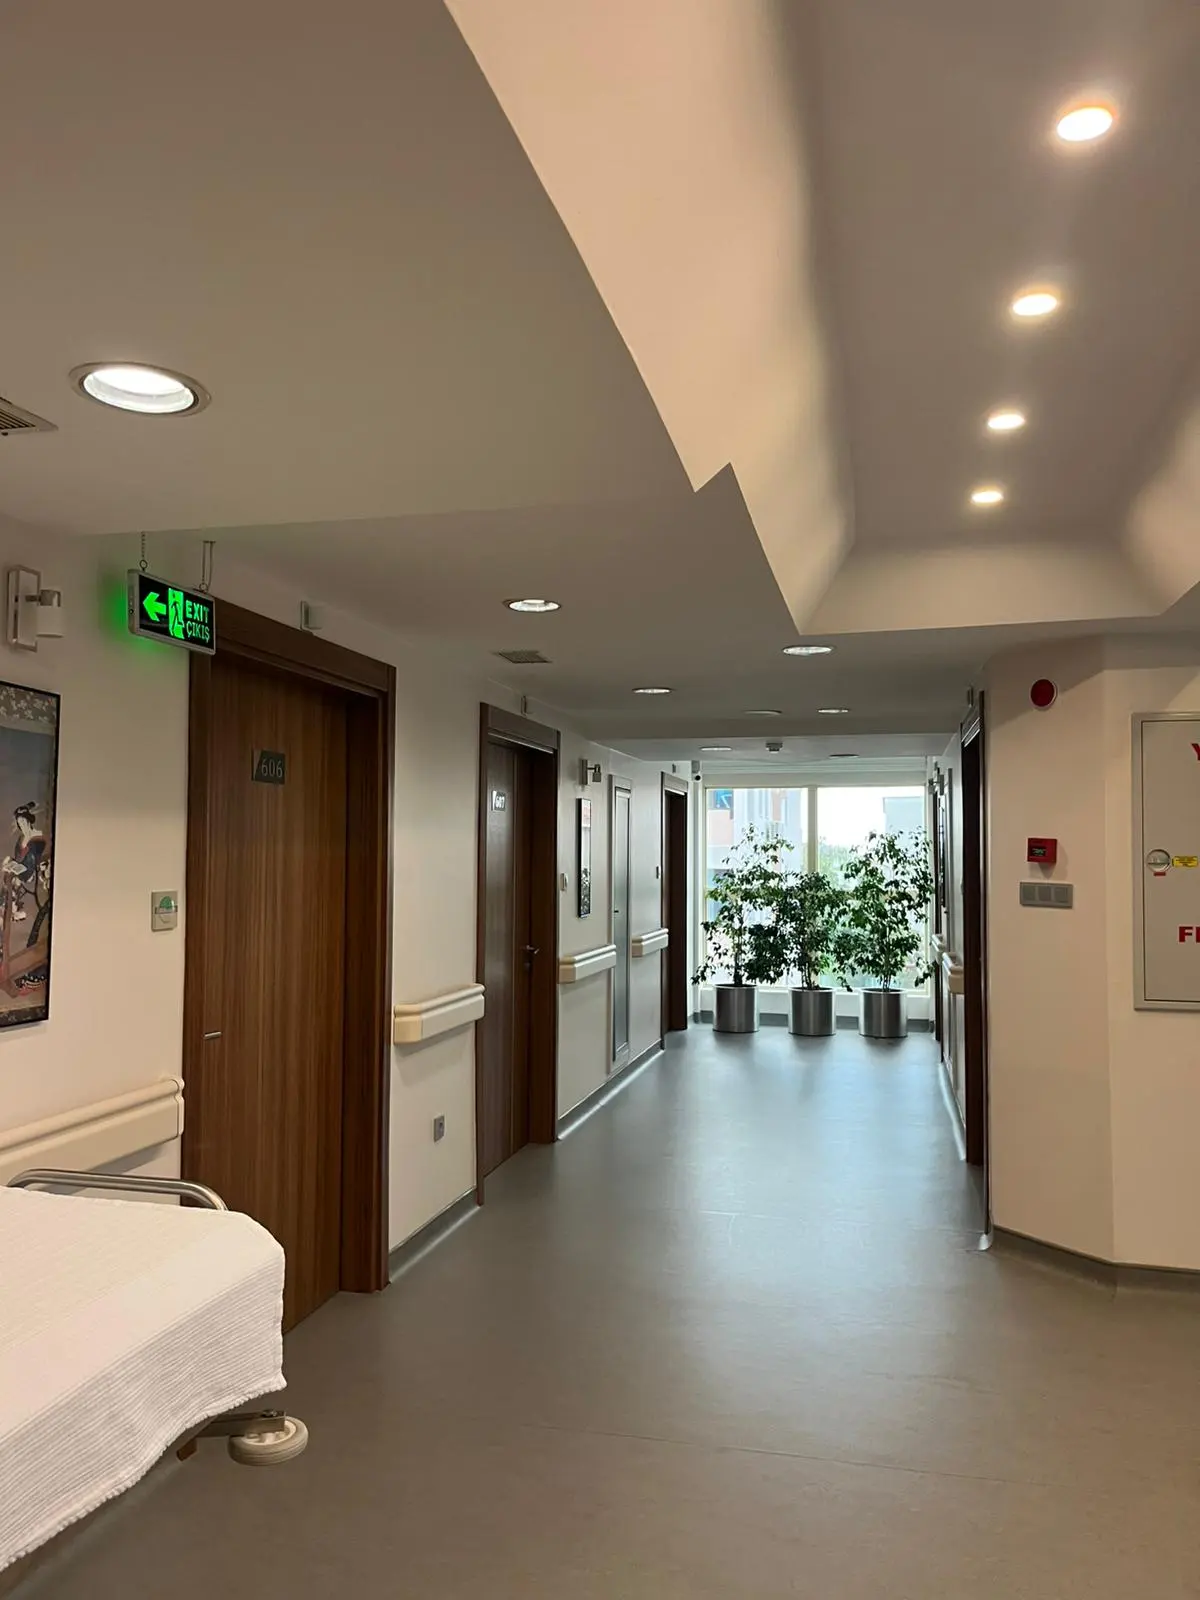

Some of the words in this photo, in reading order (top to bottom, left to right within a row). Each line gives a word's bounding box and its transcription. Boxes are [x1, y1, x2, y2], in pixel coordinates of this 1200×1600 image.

[186, 600, 209, 623] EXIT
[186, 621, 210, 643] ÇIKIŞ
[261, 758, 283, 778] 606
